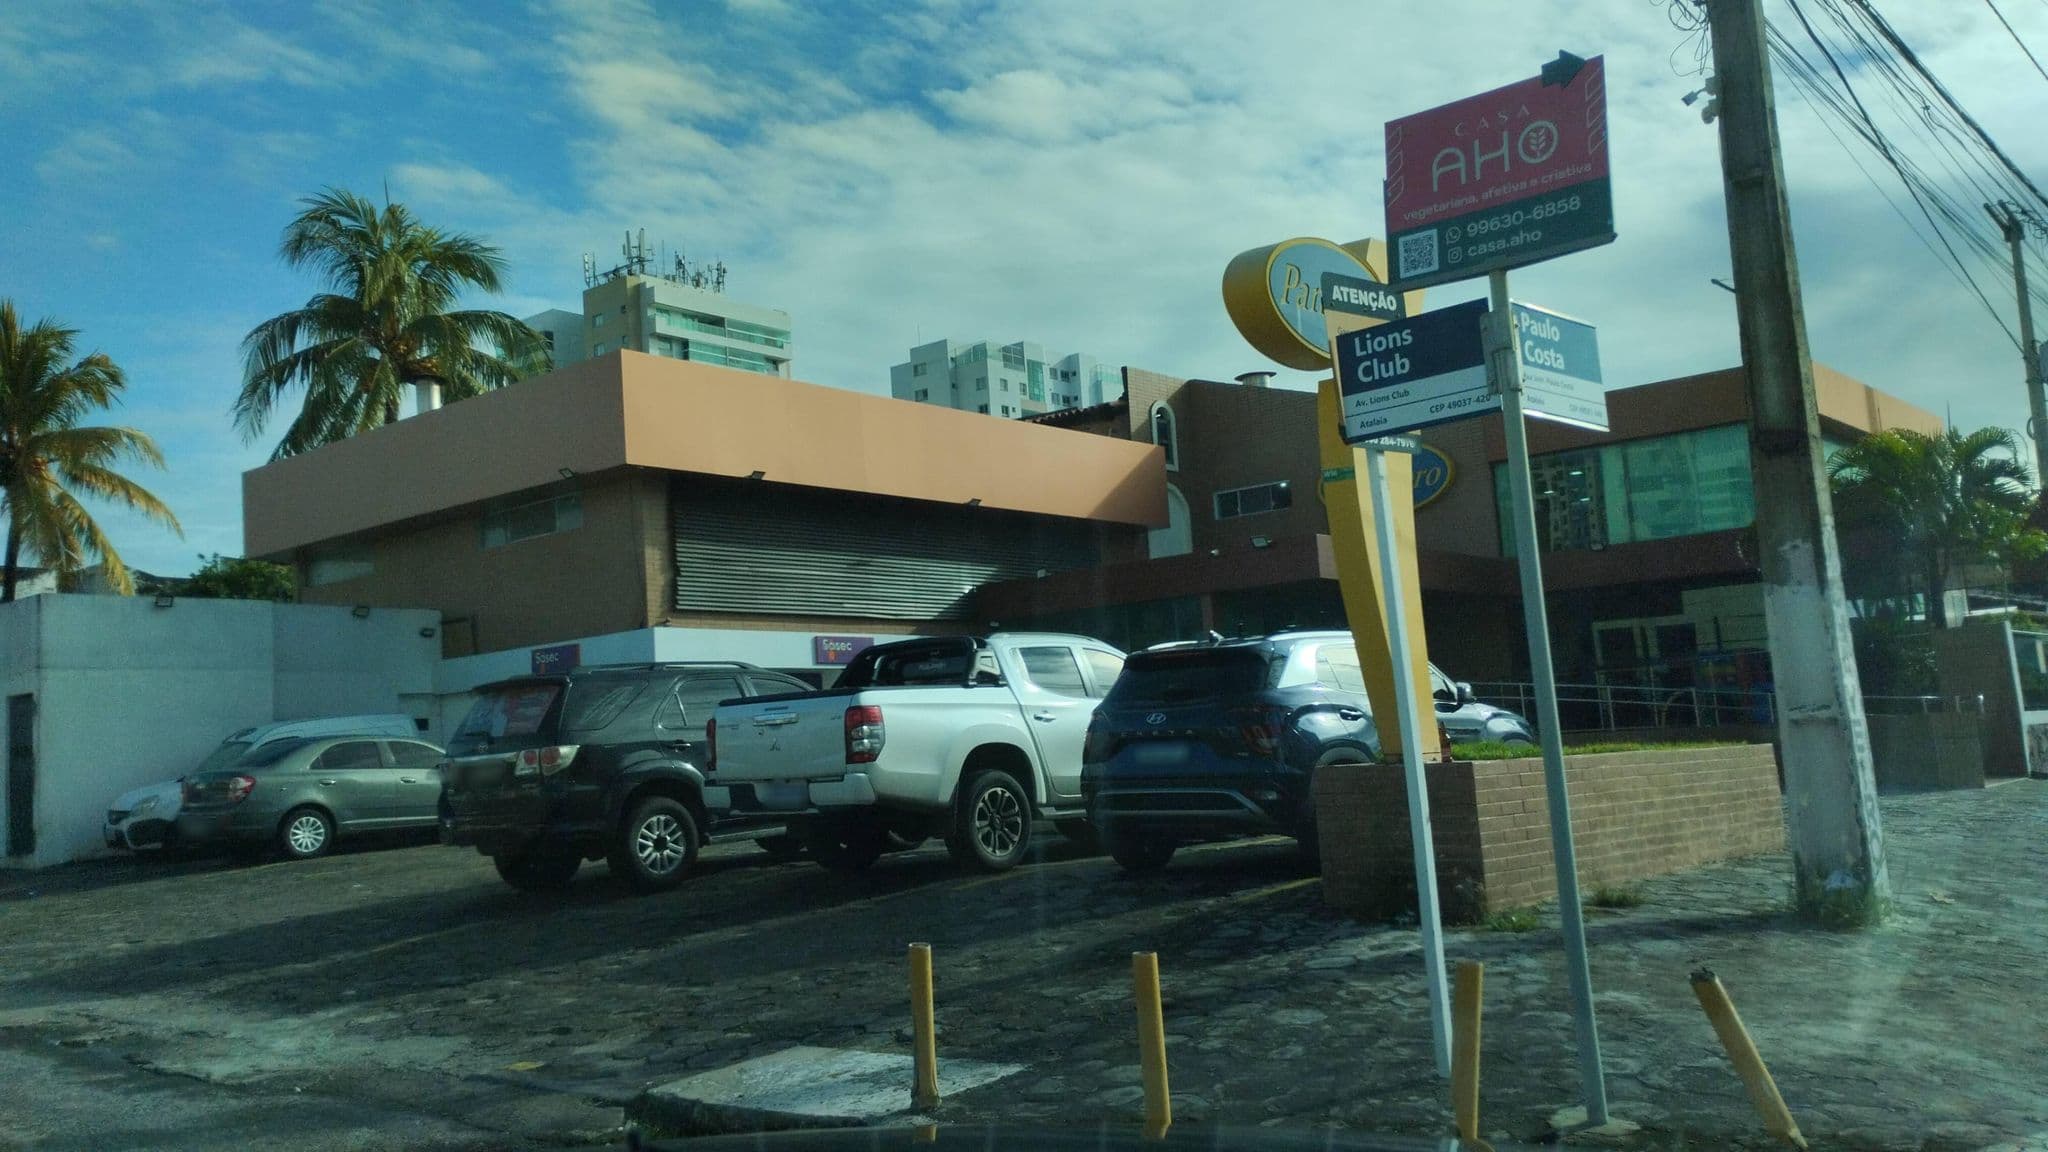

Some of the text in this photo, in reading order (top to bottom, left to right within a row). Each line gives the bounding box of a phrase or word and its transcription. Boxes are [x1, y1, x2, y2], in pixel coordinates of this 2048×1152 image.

[1455, 104, 1530, 136] CASA
[1432, 120, 1559, 193] AHO
[1403, 195, 1479, 221] vegetariana,
[1482, 180, 1527, 200] afetiva
[1541, 163, 1592, 183] criativa
[1466, 196, 1581, 237] 99630-6858
[1467, 229, 1542, 257] casa.aho
[1332, 284, 1397, 311] ATENÇÃO
[1520, 311, 1560, 342] Paulo
[1354, 328, 1414, 357] Lions
[1524, 340, 1565, 370] Costa
[1357, 353, 1411, 383] Club
[1355, 388, 1410, 408] Av. Lions Club
[1360, 415, 1388, 429] Atalaia
[1429, 402, 1445, 414] CEP
